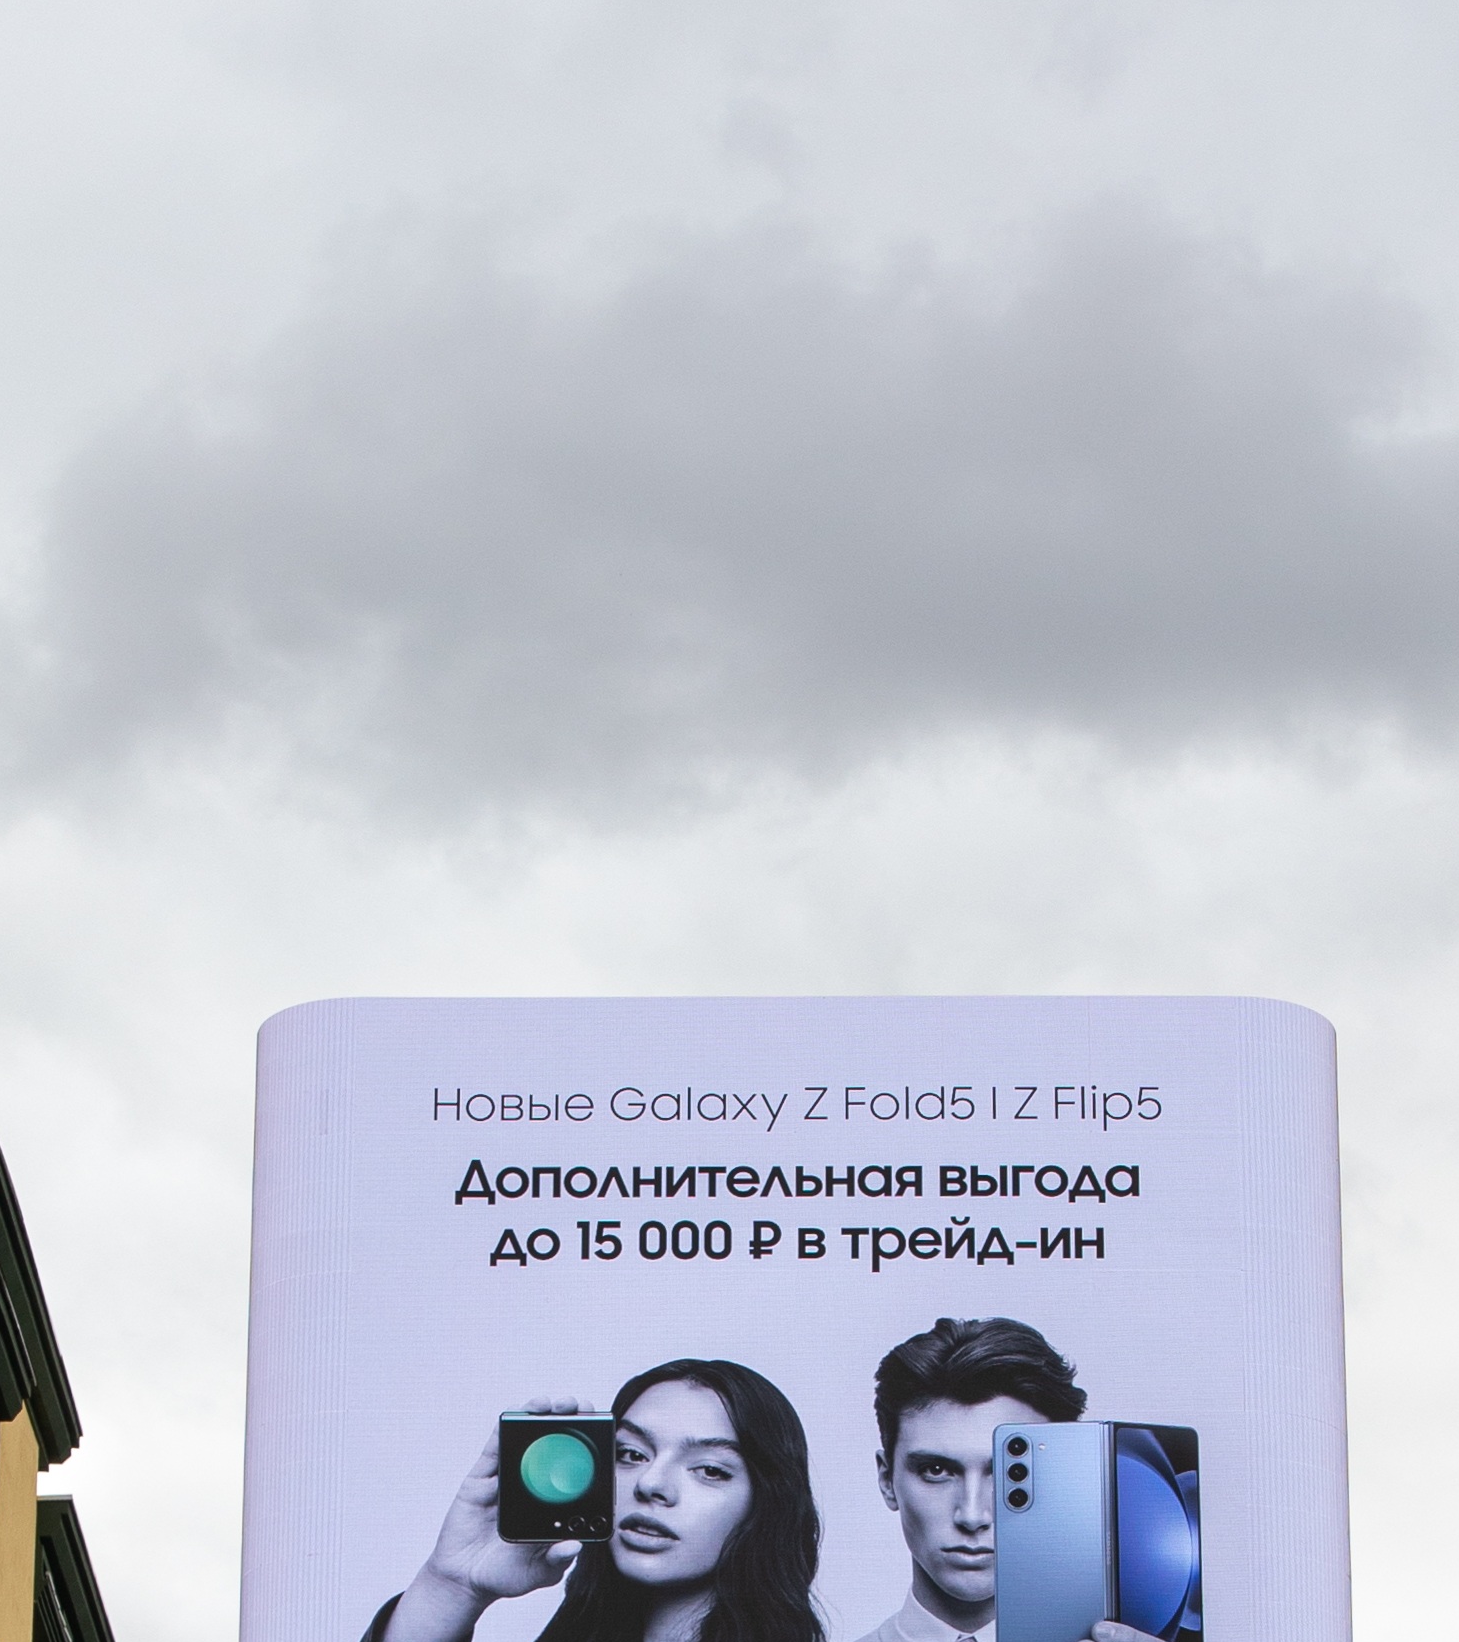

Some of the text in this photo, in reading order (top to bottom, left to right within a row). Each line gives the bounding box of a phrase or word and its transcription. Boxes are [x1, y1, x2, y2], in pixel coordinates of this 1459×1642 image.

[433, 1087, 595, 1122] Новые
[610, 1086, 789, 1133] Galaxy
[803, 1086, 829, 1120] Z
[844, 1085, 975, 1121] Fold5
[1013, 1086, 1039, 1120] Z
[1054, 1084, 1162, 1132] Flip5
[454, 1159, 1140, 1206] Дополнительная выгода
[489, 1227, 561, 1267] до
[576, 1220, 623, 1261] 15
[638, 1219, 733, 1261] 000
[797, 1227, 827, 1260] в
[840, 1219, 1105, 1273] трейд-ин
